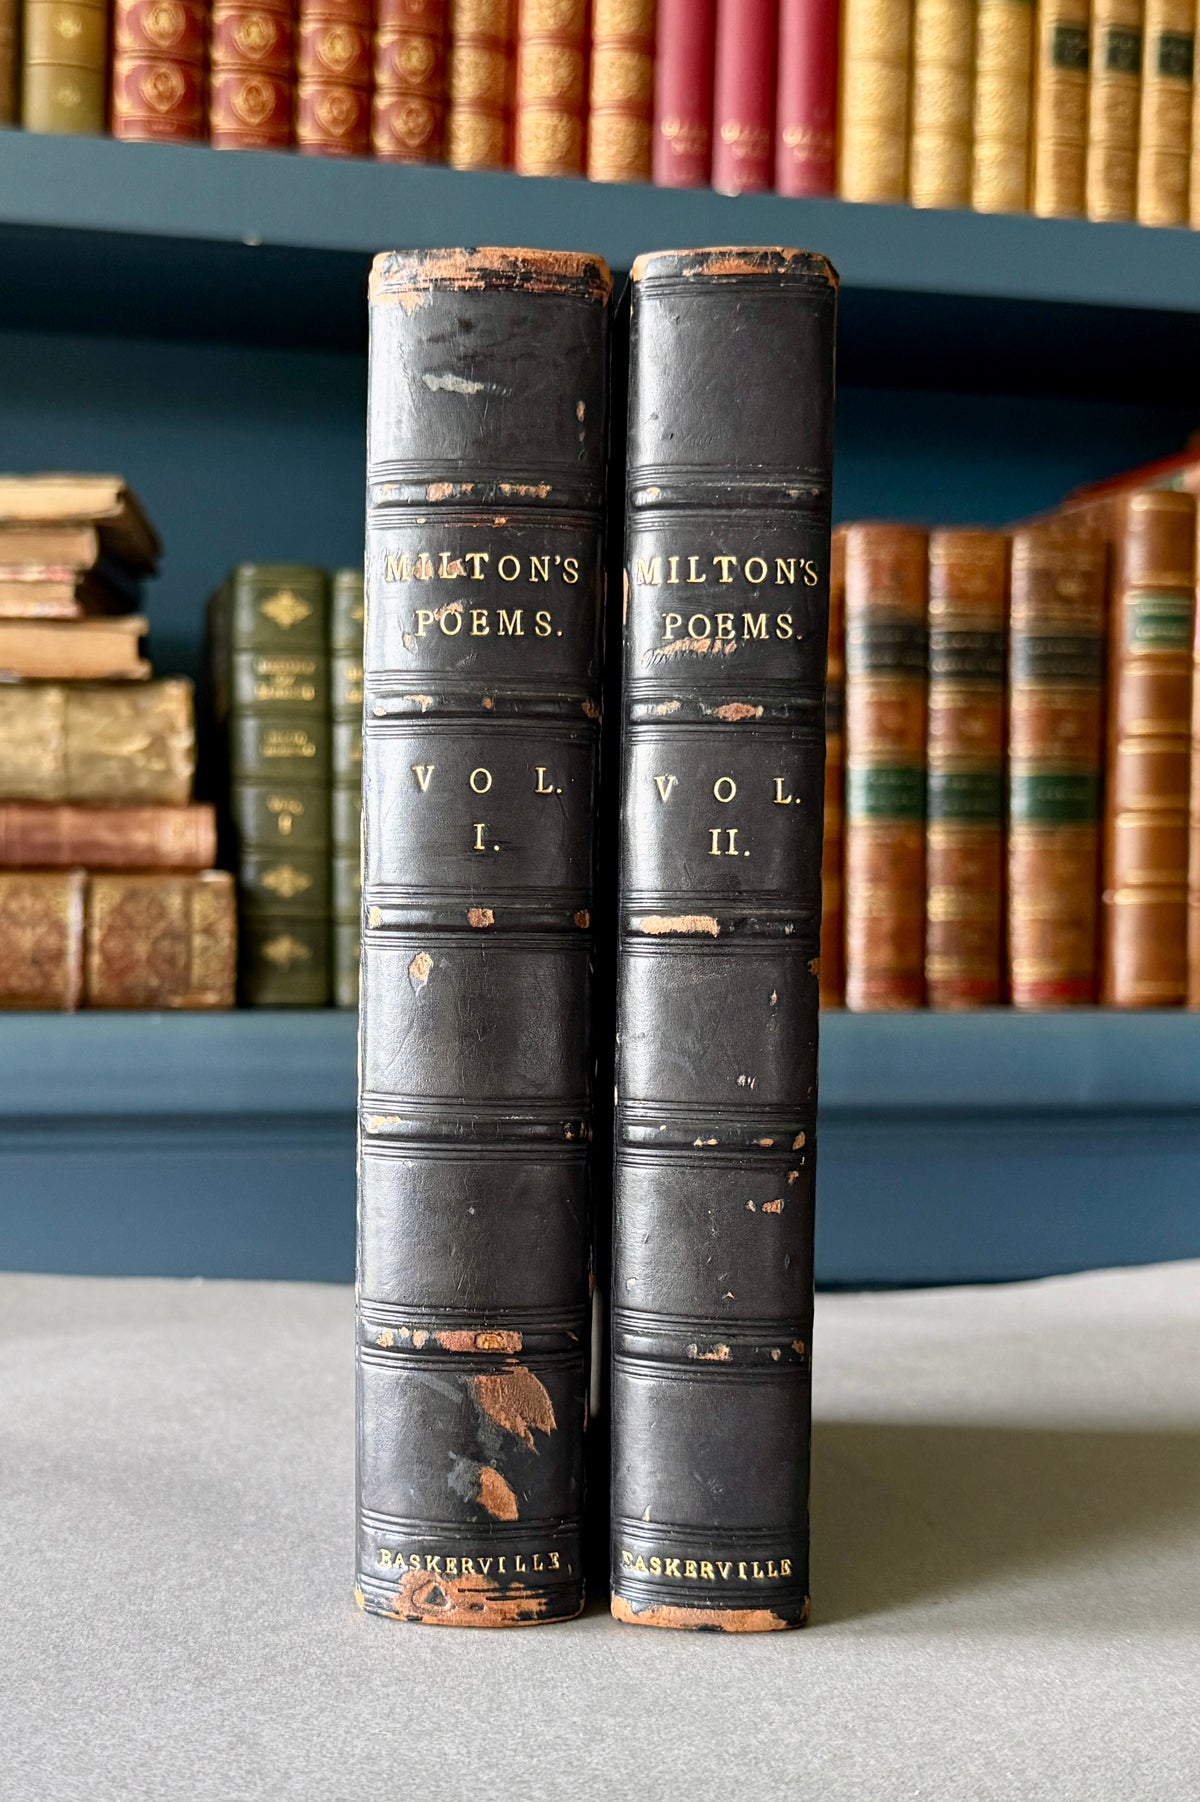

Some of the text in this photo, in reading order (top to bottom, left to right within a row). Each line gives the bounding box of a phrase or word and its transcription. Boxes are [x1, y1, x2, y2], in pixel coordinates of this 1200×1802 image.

[385, 552, 579, 584] MILTON'S
[636, 556, 818, 587] MILTON'S
[414, 609, 563, 637] POEMS.
[662, 613, 803, 641] POEMS.
[473, 823, 501, 851] I.
[709, 828, 750, 857] II.
[378, 1548, 561, 1575] BASKERVILLE
[621, 1550, 793, 1580] BASKERVILLE
